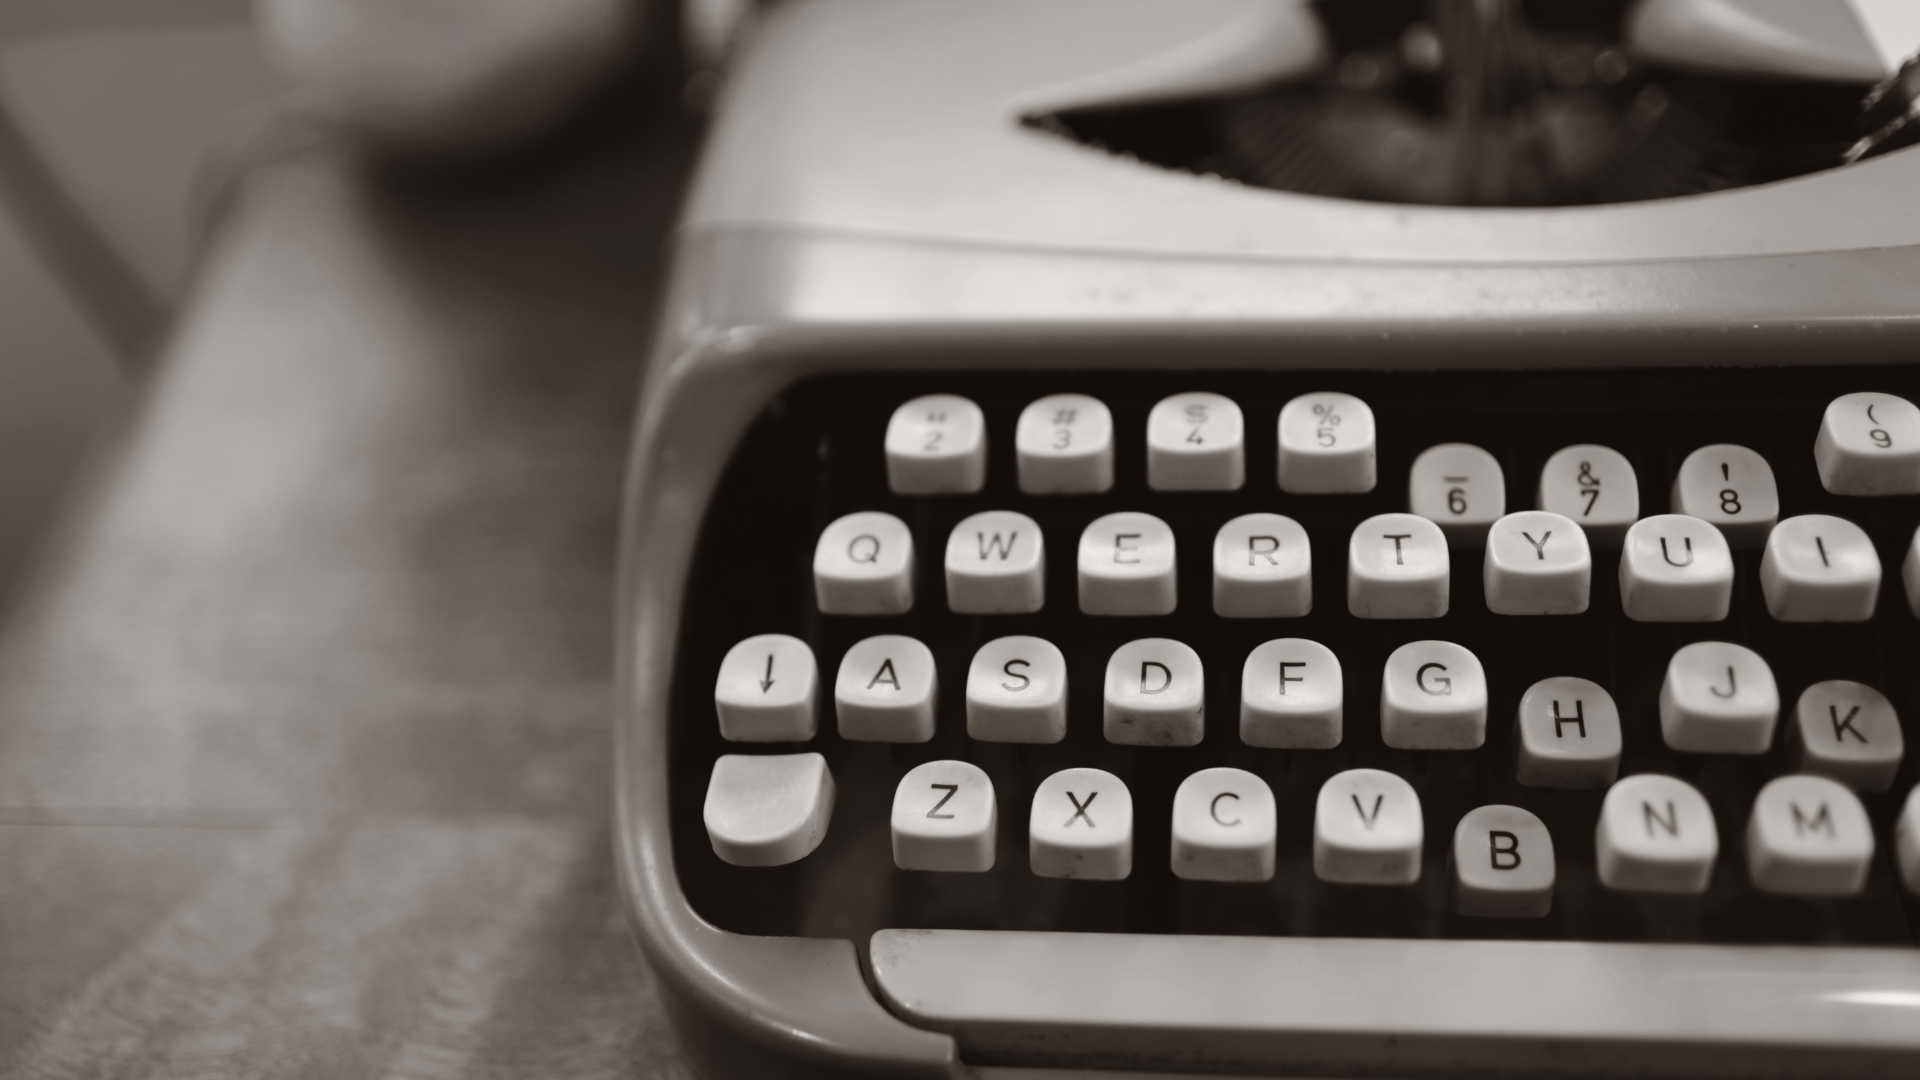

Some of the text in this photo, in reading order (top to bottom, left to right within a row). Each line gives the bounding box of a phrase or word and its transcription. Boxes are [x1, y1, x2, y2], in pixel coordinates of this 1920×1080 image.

[1052, 408, 1079, 426] #
[1184, 404, 1209, 424] $
[1312, 404, 1341, 426] %
[1867, 404, 1880, 425] (
[923, 431, 944, 451] 2
[1053, 430, 1071, 450] 3
[1186, 428, 1204, 446] 4
[1317, 428, 1336, 447] 5
[1869, 429, 1892, 448] 9
[1578, 461, 1600, 486] &
[1448, 488, 1467, 515] 6
[1580, 490, 1600, 516] 7
[1720, 489, 1742, 515] 8
[847, 533, 880, 564] Q
[977, 531, 1017, 561] W
[1114, 534, 1141, 564] E
[1248, 535, 1280, 566] R
[1383, 534, 1412, 565] T
[1522, 531, 1552, 560] Y
[1660, 537, 1693, 567] U
[1815, 537, 1830, 567] I
[866, 658, 901, 691] A
[1001, 660, 1031, 691] S
[1140, 661, 1172, 694] D
[1279, 662, 1306, 696] F
[1416, 662, 1451, 696] G
[1710, 666, 1736, 699] J
[1553, 700, 1586, 739] H
[1829, 705, 1868, 744] K
[927, 784, 958, 819] Z
[1064, 792, 1098, 828] X
[1210, 793, 1240, 826] C
[1352, 794, 1383, 830] V
[1642, 801, 1679, 838] N
[1790, 802, 1836, 839] M
[1489, 831, 1521, 870] B
